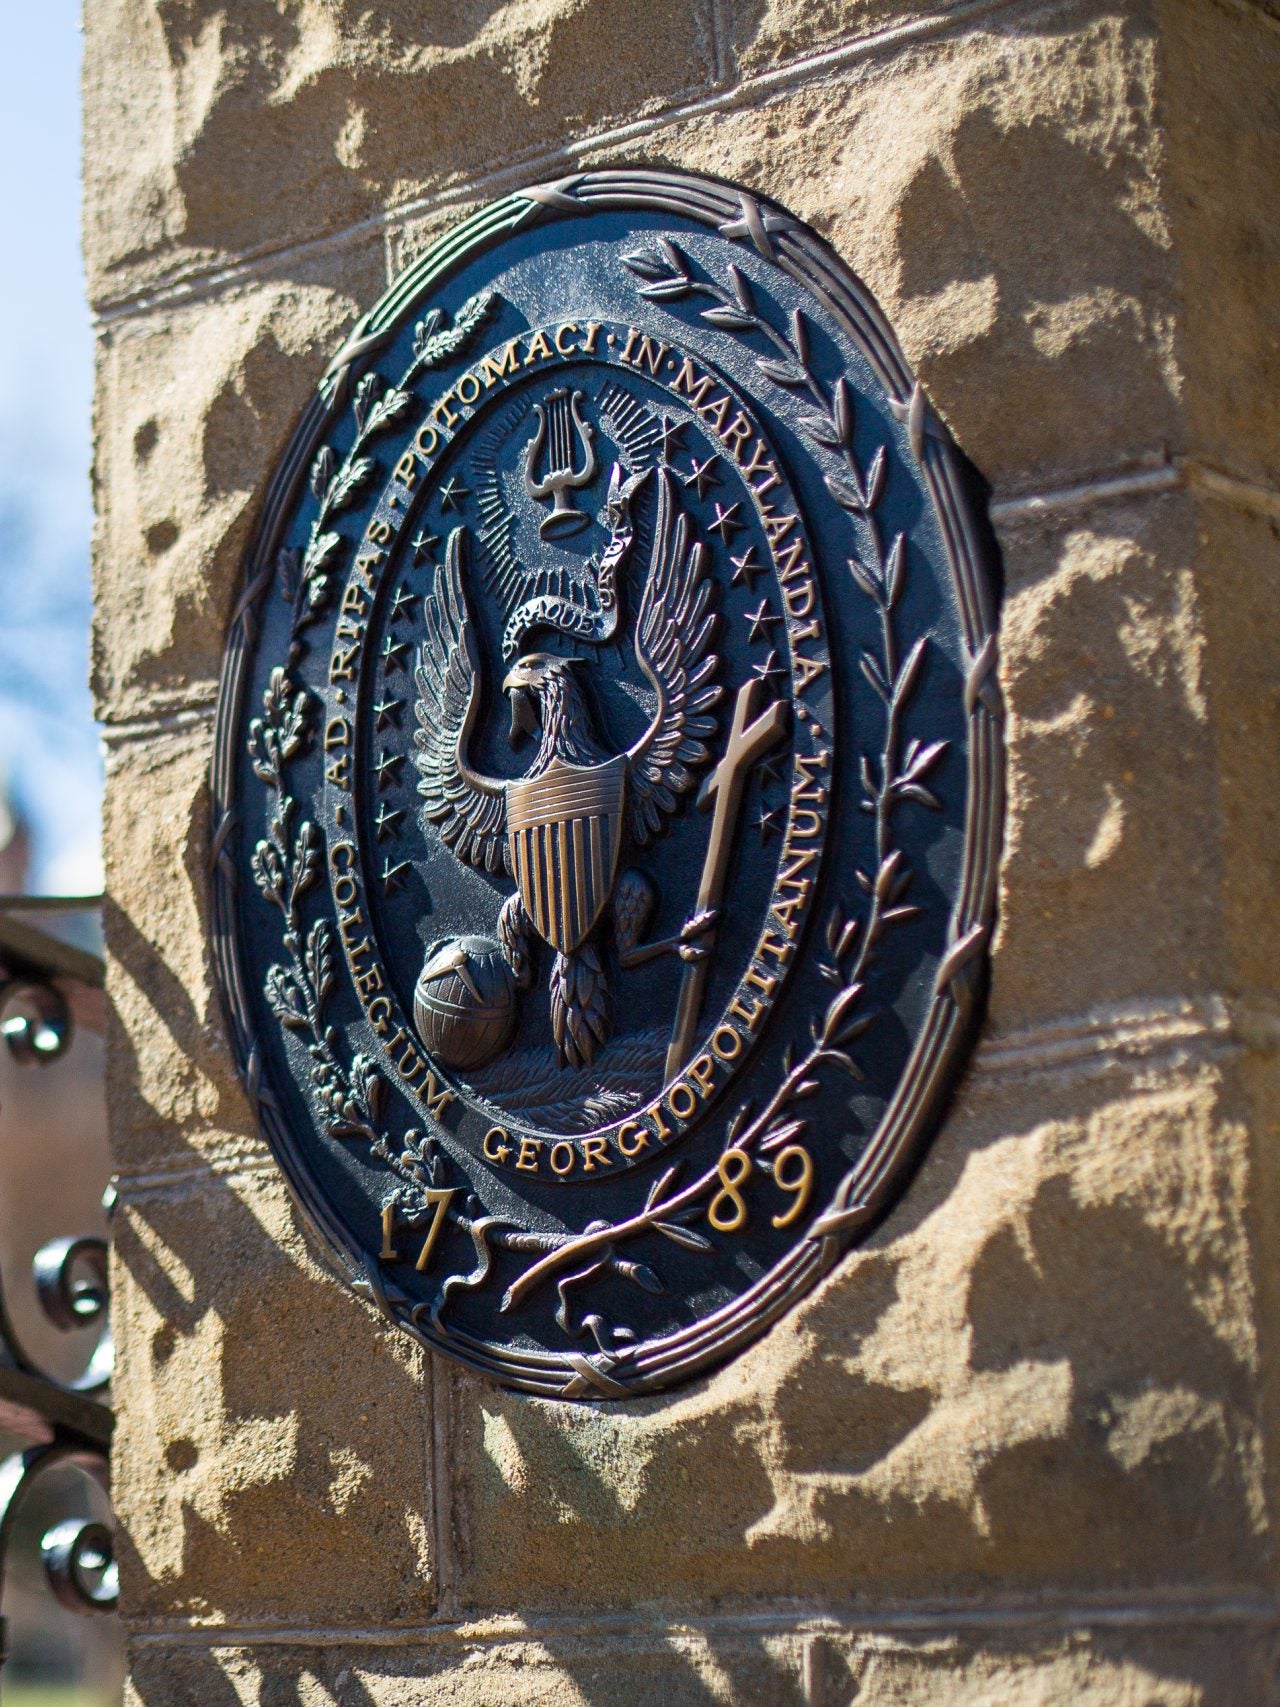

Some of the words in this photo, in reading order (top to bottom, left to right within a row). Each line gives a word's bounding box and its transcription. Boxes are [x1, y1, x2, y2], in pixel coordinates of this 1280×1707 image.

[393, 321, 601, 490] POTOMACI
[620, 327, 669, 375] IN
[328, 520, 392, 684] RIPAS
[669, 357, 826, 695] MARYLANDIA
[324, 715, 350, 787] AD
[330, 842, 455, 1121] COLLEGIUM
[483, 750, 827, 1176] GEORGIOPOLITANUM
[708, 1145, 814, 1233] 89
